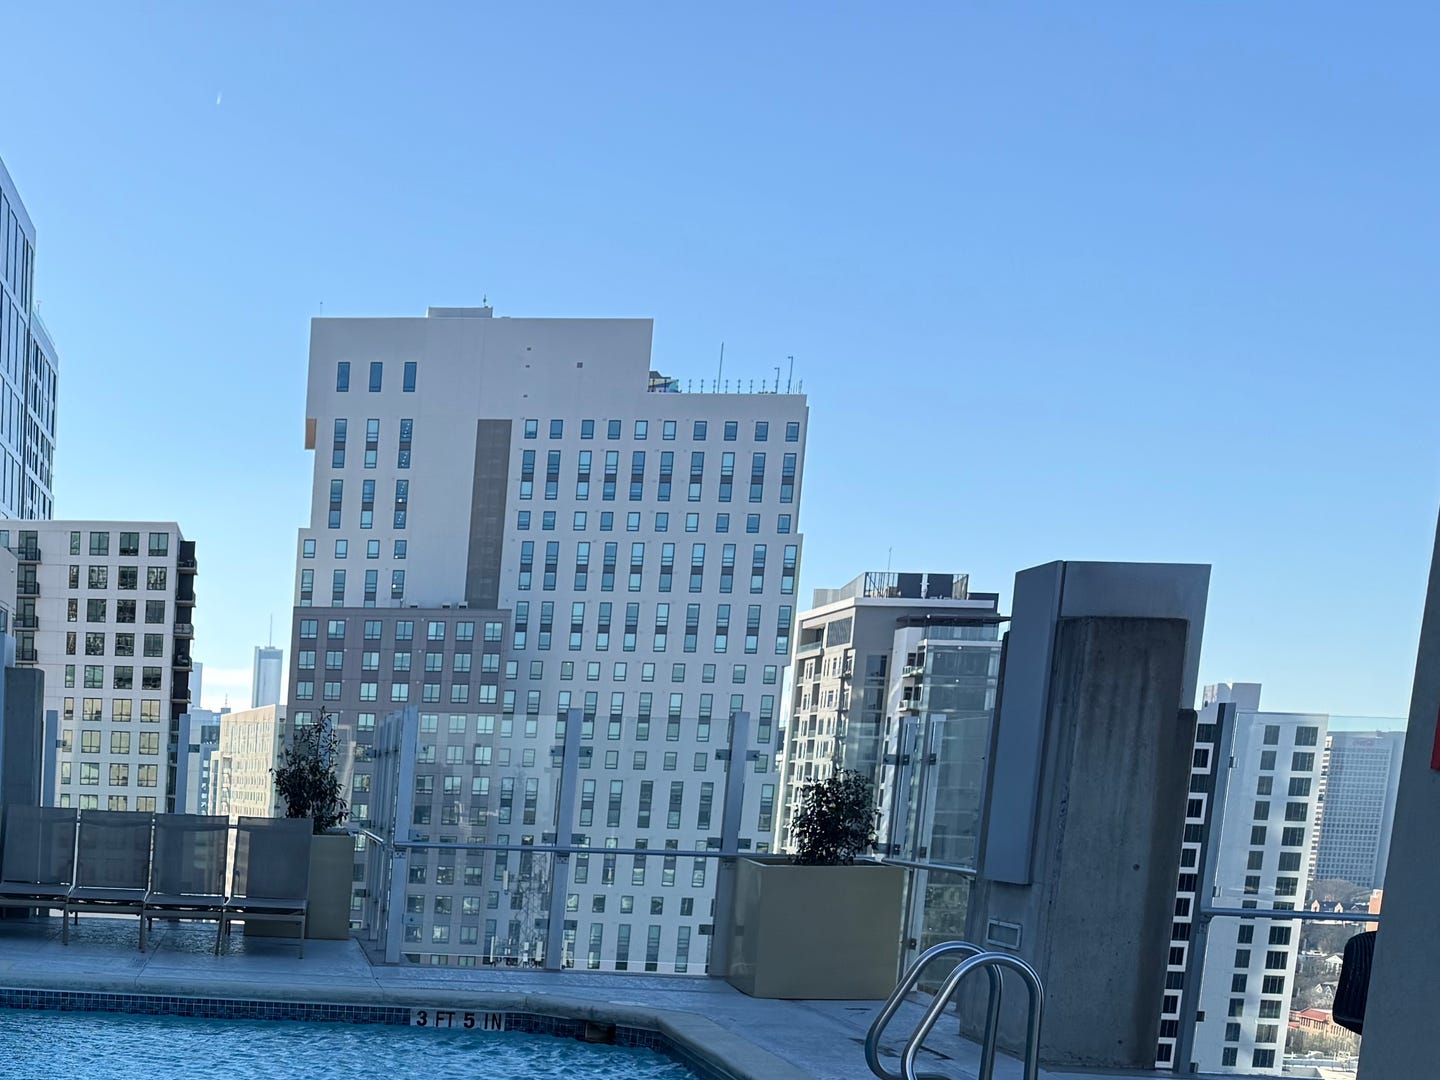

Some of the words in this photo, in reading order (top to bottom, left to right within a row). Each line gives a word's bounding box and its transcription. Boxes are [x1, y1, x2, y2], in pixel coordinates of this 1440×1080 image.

[416, 1010, 428, 1026] 3
[436, 1012, 455, 1028] FT
[464, 1012, 475, 1028] 5
[484, 1013, 502, 1030] IN
